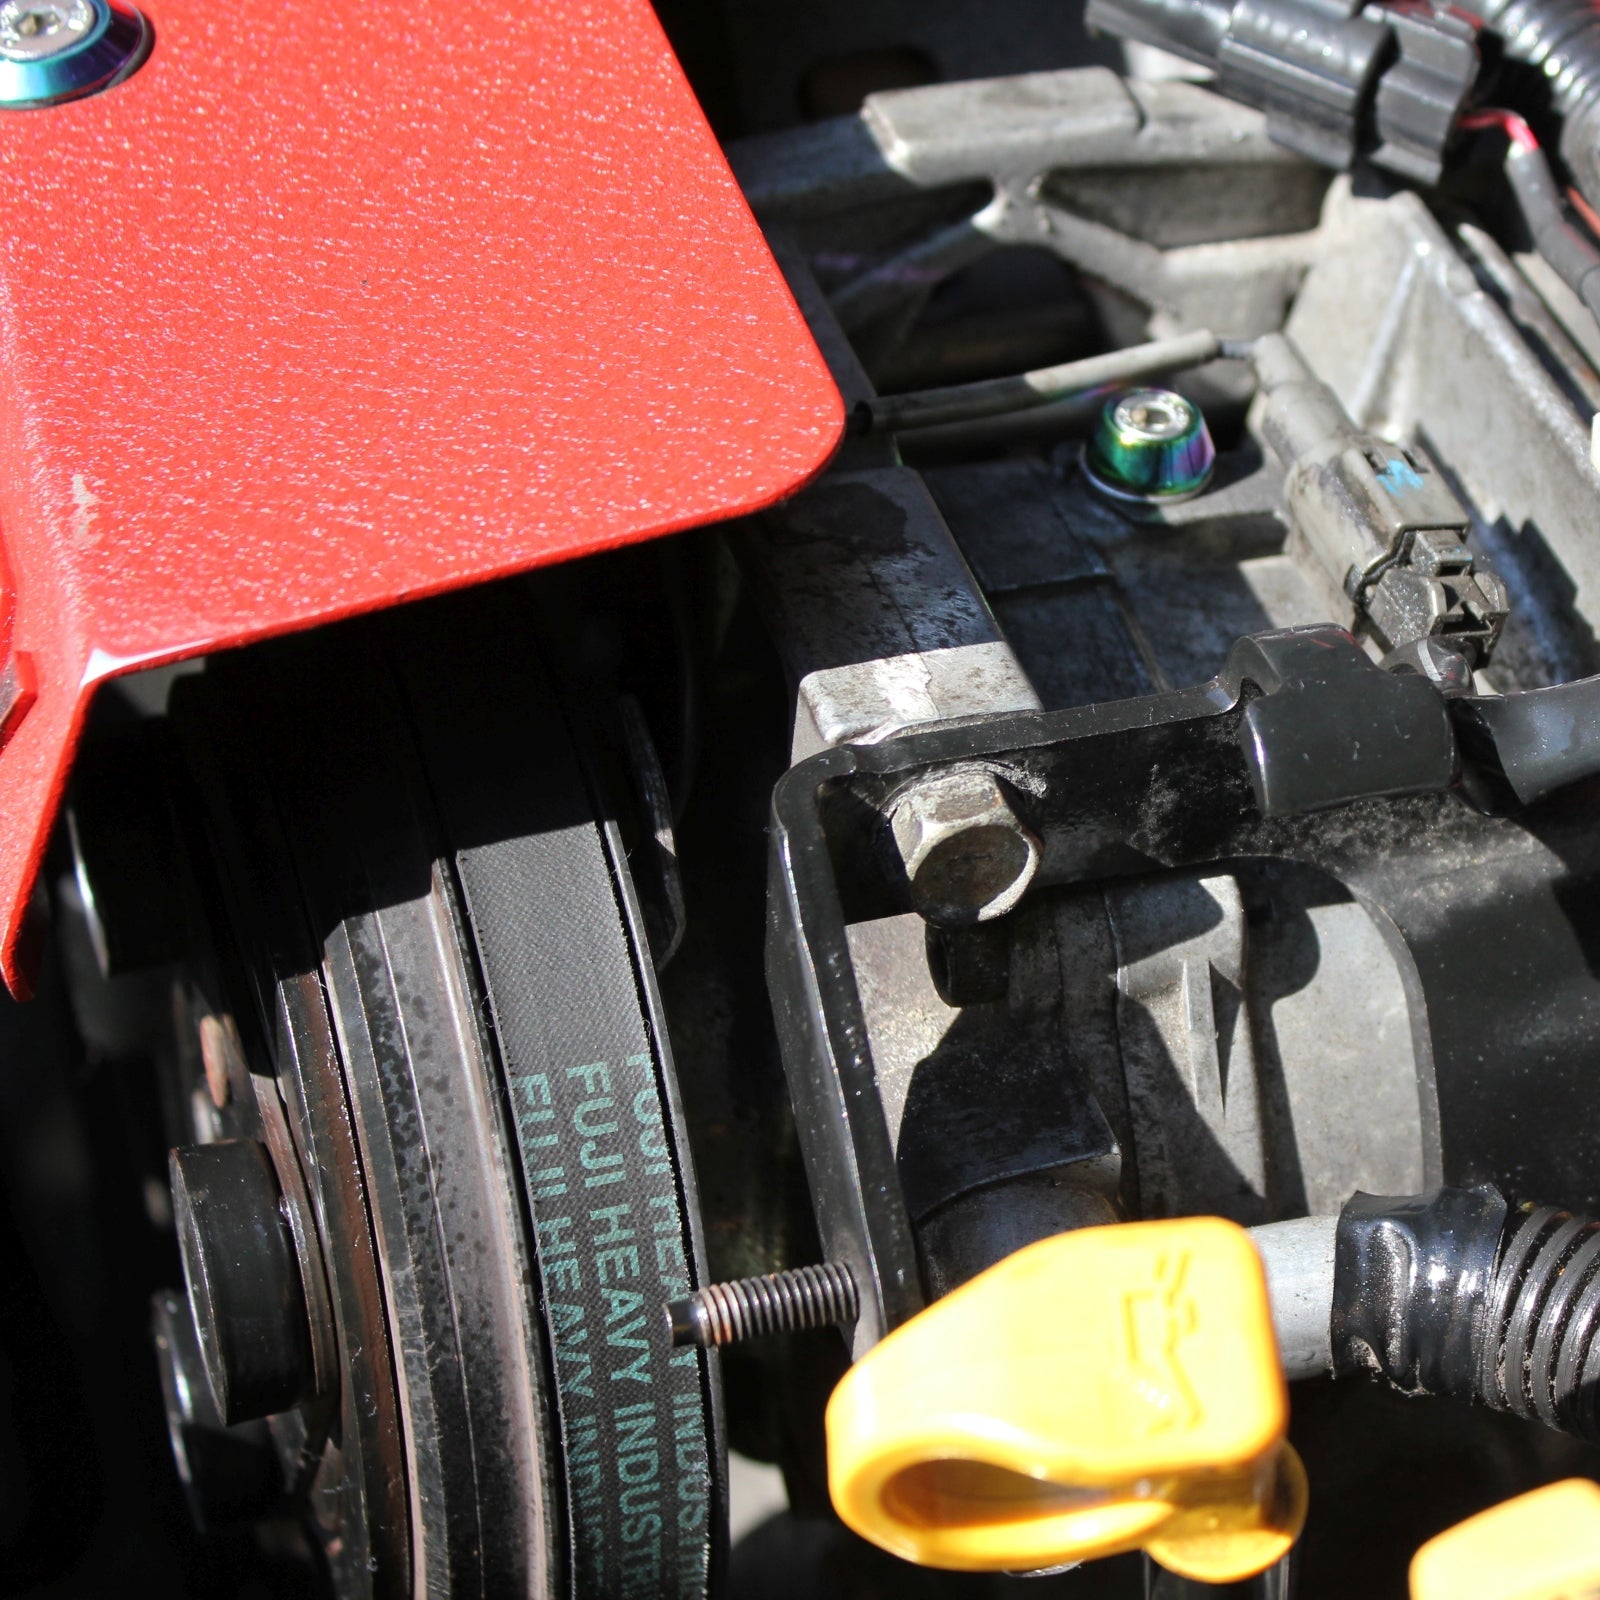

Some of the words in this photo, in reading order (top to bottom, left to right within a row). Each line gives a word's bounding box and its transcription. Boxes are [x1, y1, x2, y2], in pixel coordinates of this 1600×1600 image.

[566, 1062, 627, 1188] FUJI
[590, 1203, 653, 1384] HEAVY
[650, 1195, 698, 1368] HEAY
